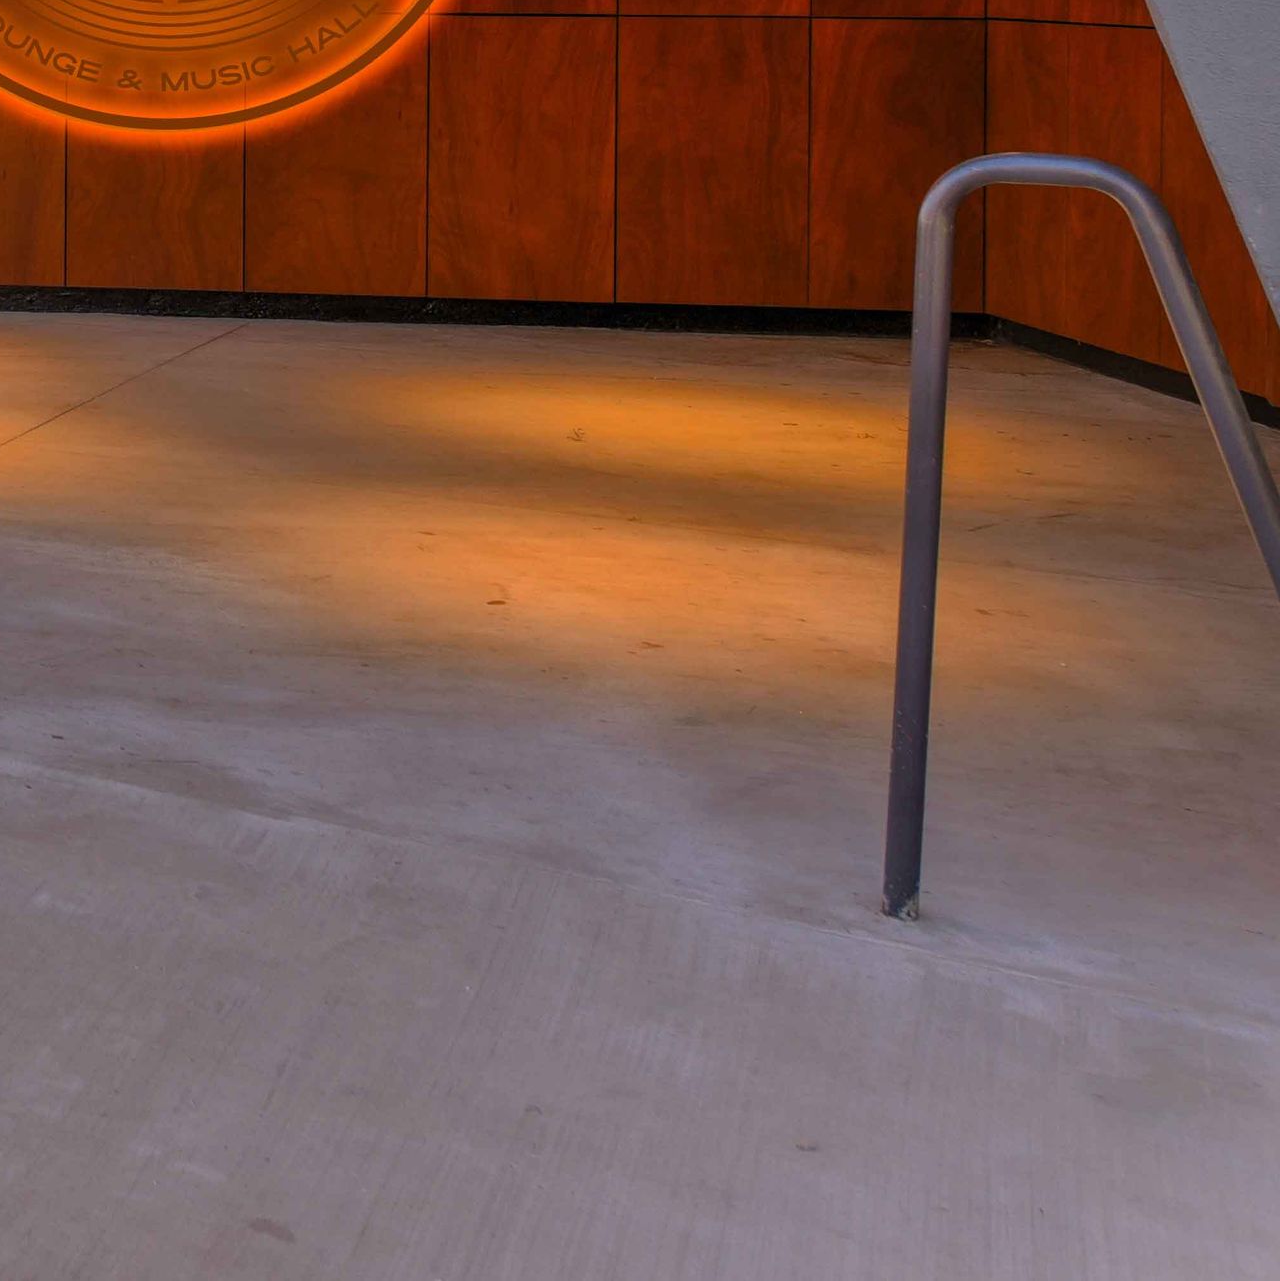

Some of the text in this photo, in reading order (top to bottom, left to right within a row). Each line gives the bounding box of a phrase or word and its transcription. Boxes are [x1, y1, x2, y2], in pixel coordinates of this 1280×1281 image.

[116, 69, 145, 91] &
[161, 56, 276, 92] MUSIC
[288, 0, 379, 63] HALL
